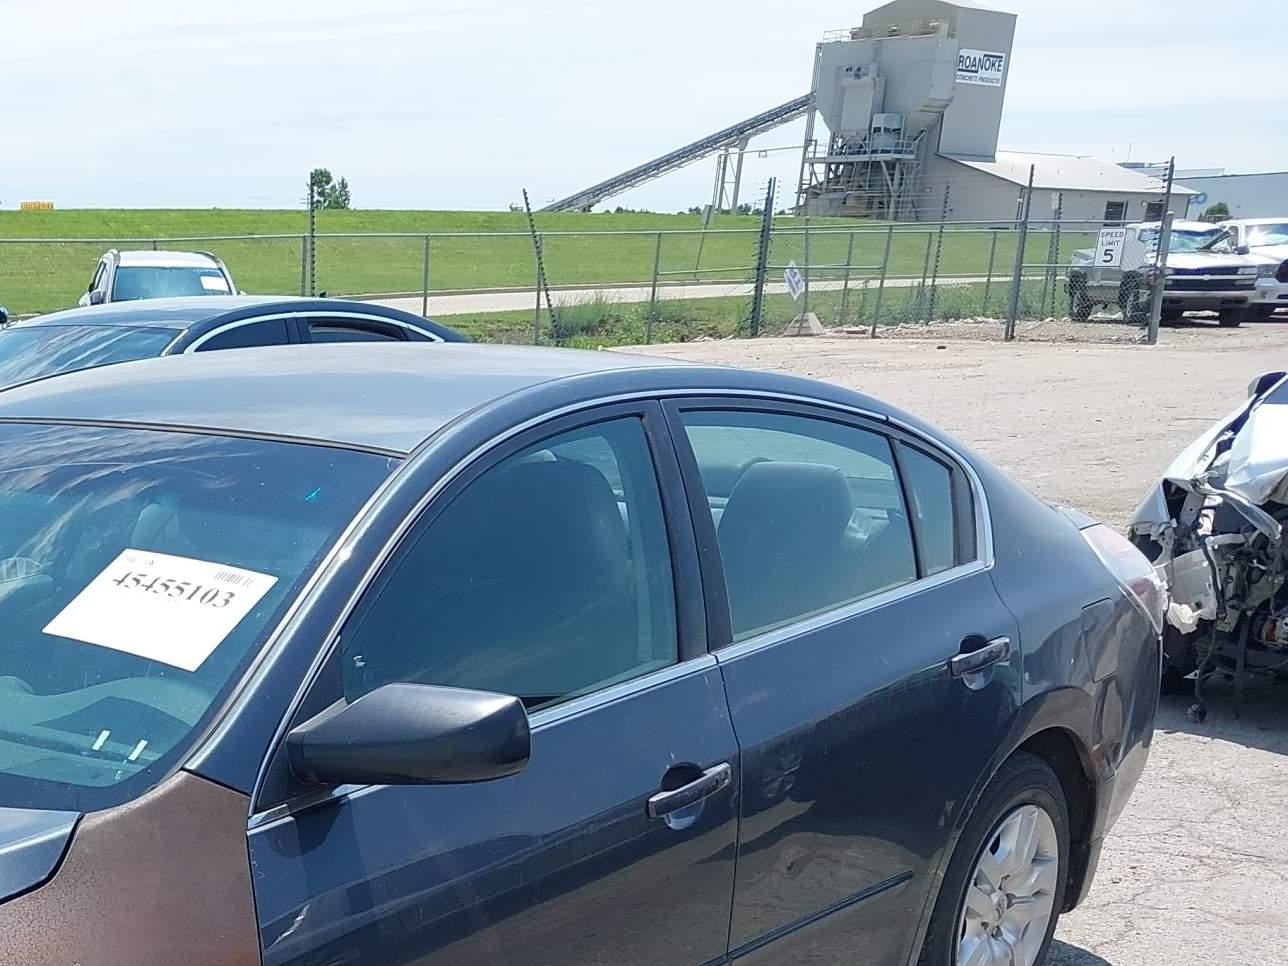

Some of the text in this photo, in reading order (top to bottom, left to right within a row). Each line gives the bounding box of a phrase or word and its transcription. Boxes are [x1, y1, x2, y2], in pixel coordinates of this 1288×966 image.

[958, 55, 1003, 72] ROANOKE
[1102, 248, 1114, 263] 5
[112, 571, 236, 608] 45455103
